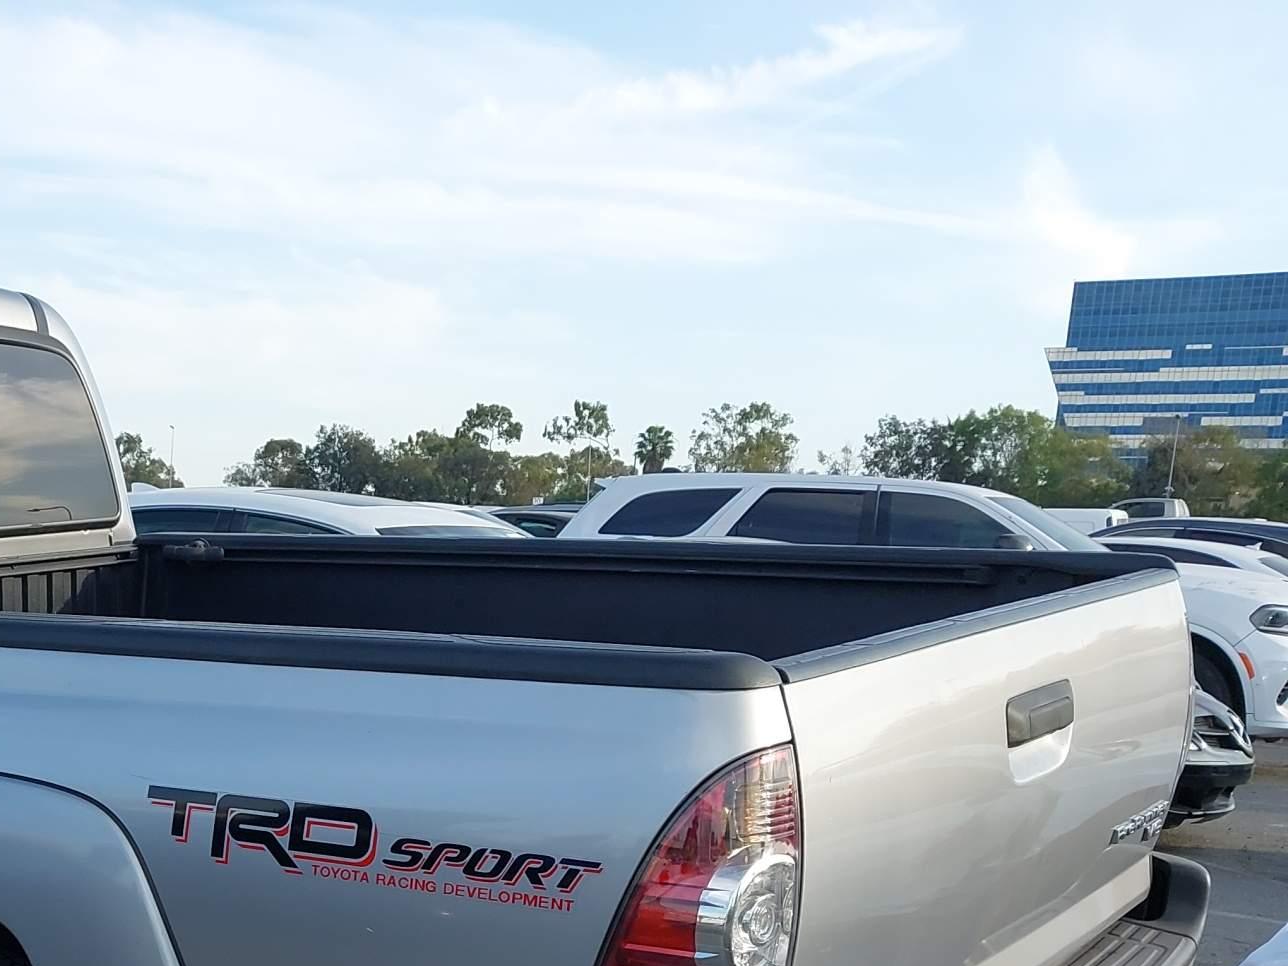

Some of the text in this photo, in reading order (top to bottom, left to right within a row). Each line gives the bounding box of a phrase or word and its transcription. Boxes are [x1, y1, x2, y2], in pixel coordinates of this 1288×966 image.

[147, 785, 604, 894] TRD SPORT
[311, 864, 575, 912] TOYOTA RACING DEVELOPMENT
